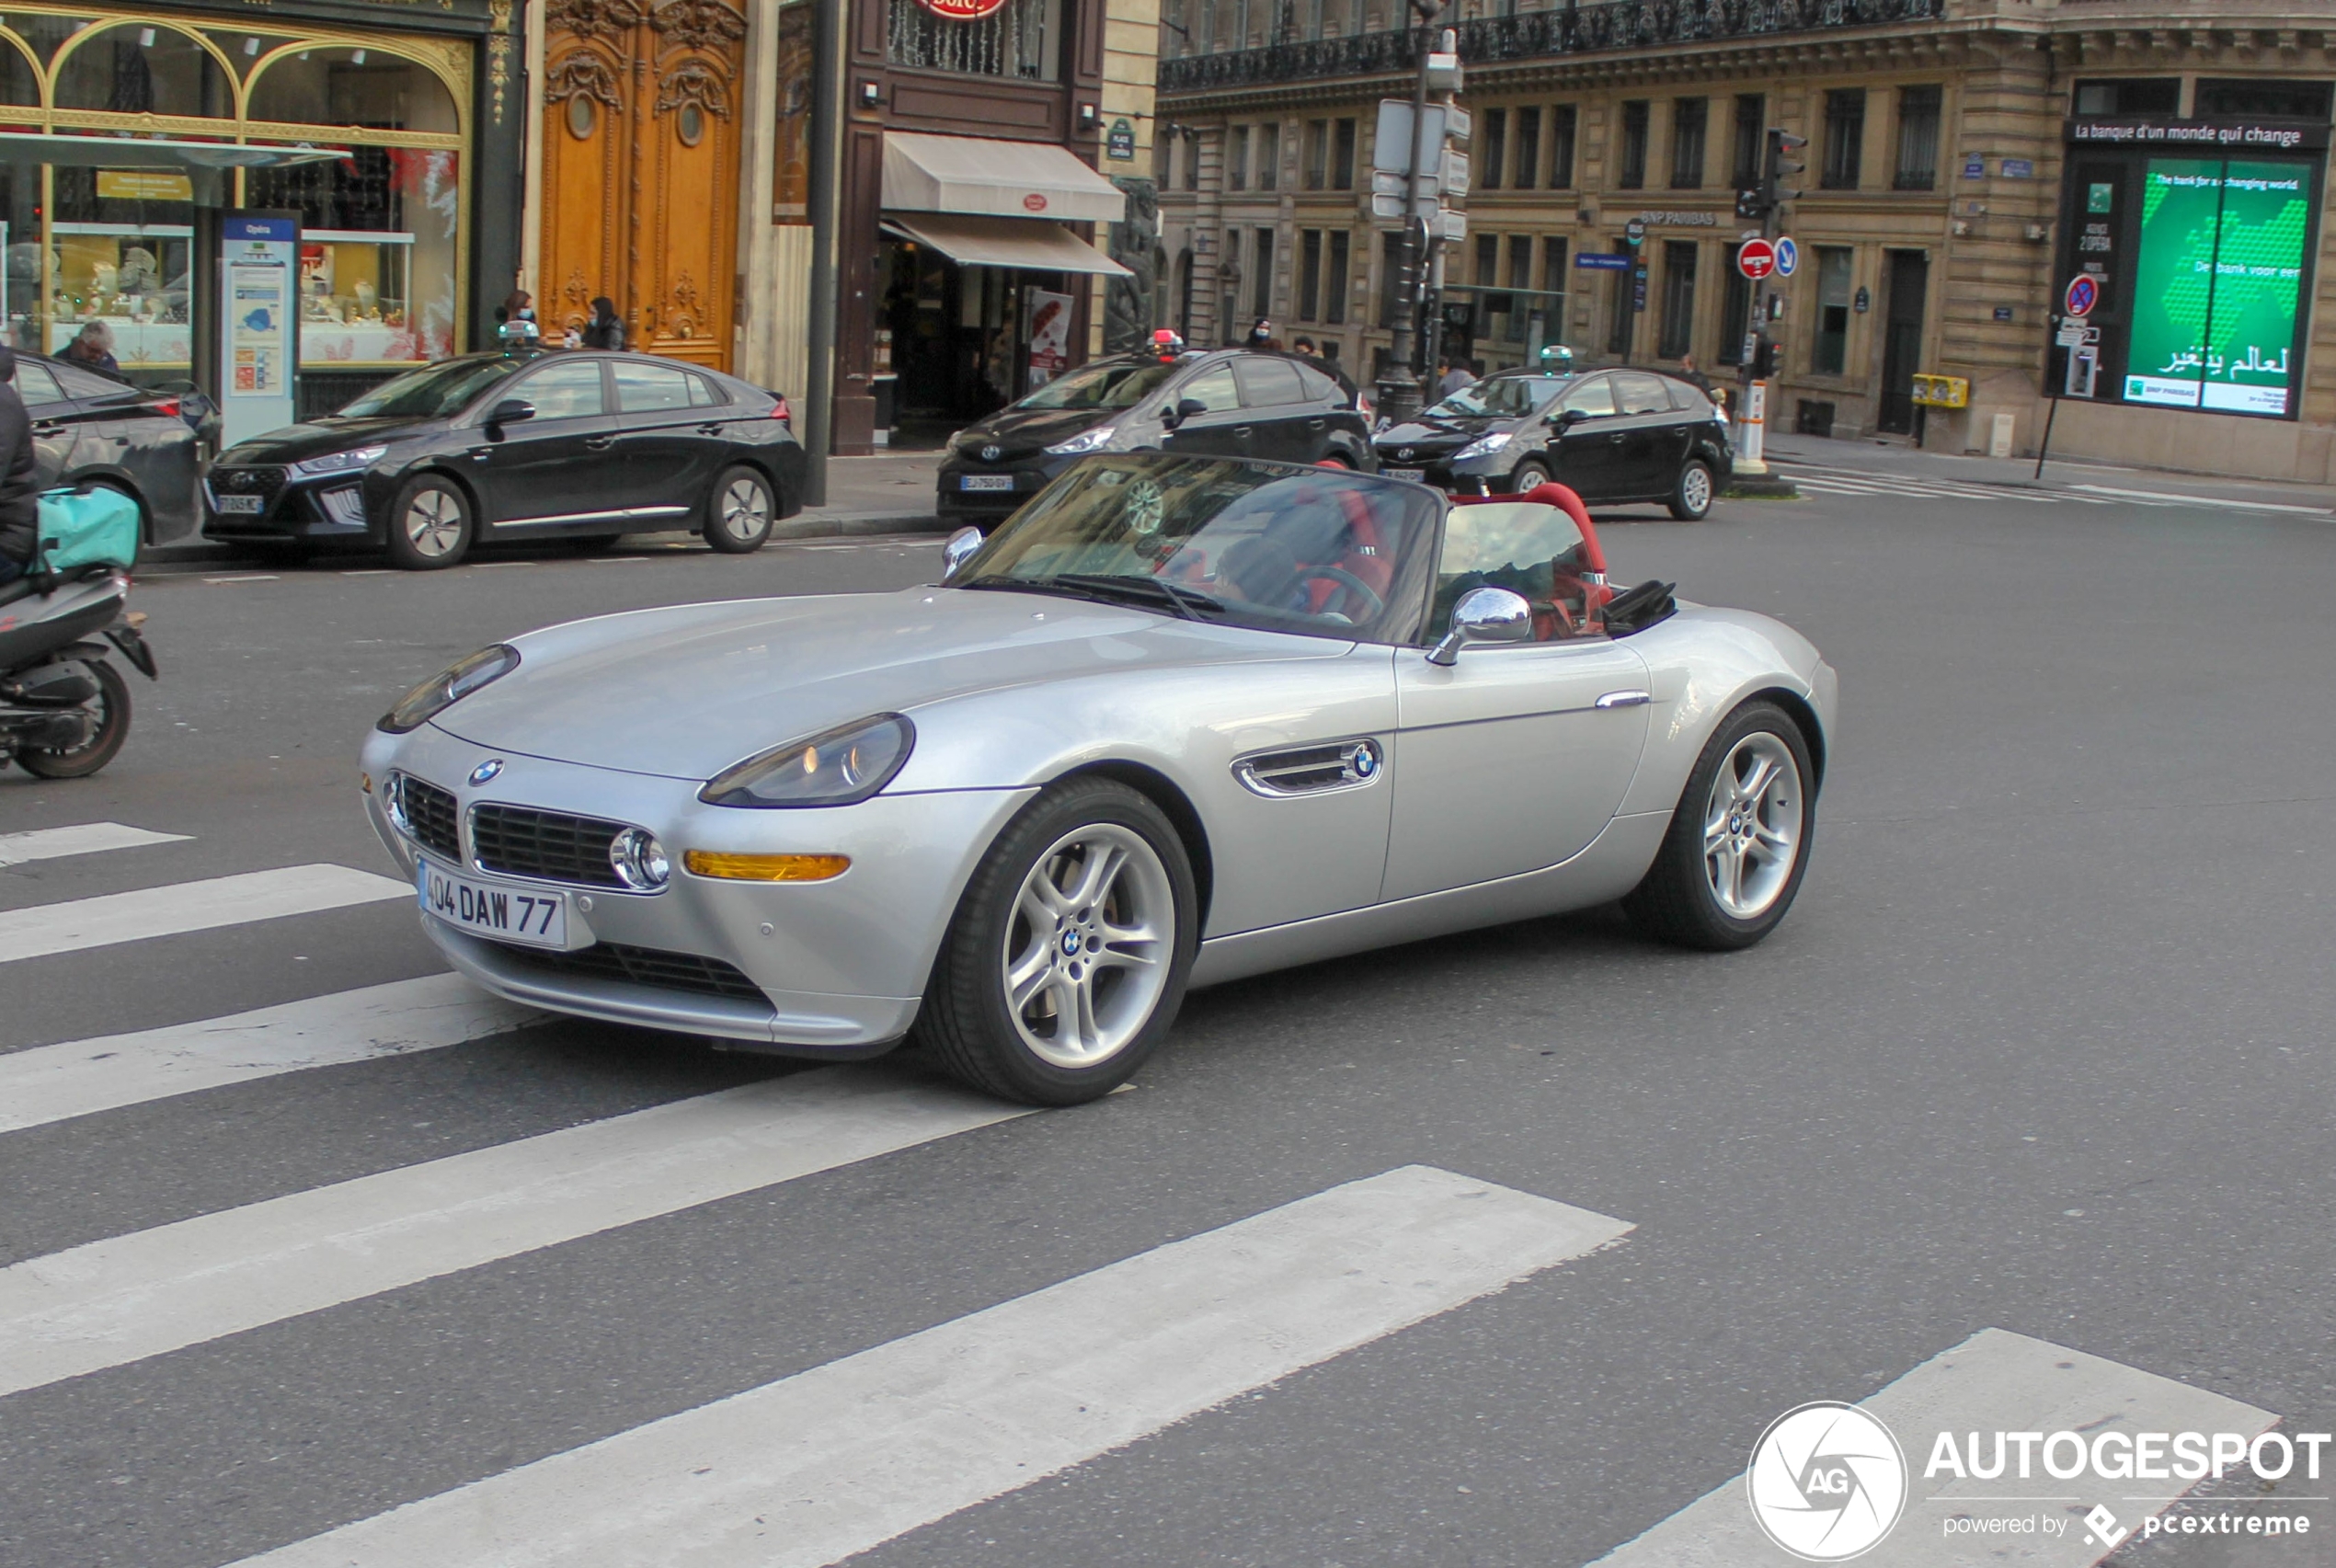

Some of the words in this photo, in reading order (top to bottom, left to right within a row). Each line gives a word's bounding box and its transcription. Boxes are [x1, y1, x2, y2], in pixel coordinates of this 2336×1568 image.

[2076, 124, 2089, 138] La
[2090, 124, 2135, 142] banque
[2136, 124, 2164, 139] d'un
[2167, 125, 2216, 140] monde
[2218, 126, 2242, 143] qui
[2245, 127, 2301, 147] change
[2157, 175, 2172, 185] The
[2173, 176, 2195, 185] bank
[2216, 261, 2246, 274] bank
[2248, 266, 2278, 276] voor
[460, 884, 508, 931] DAW
[516, 895, 557, 935] 77
